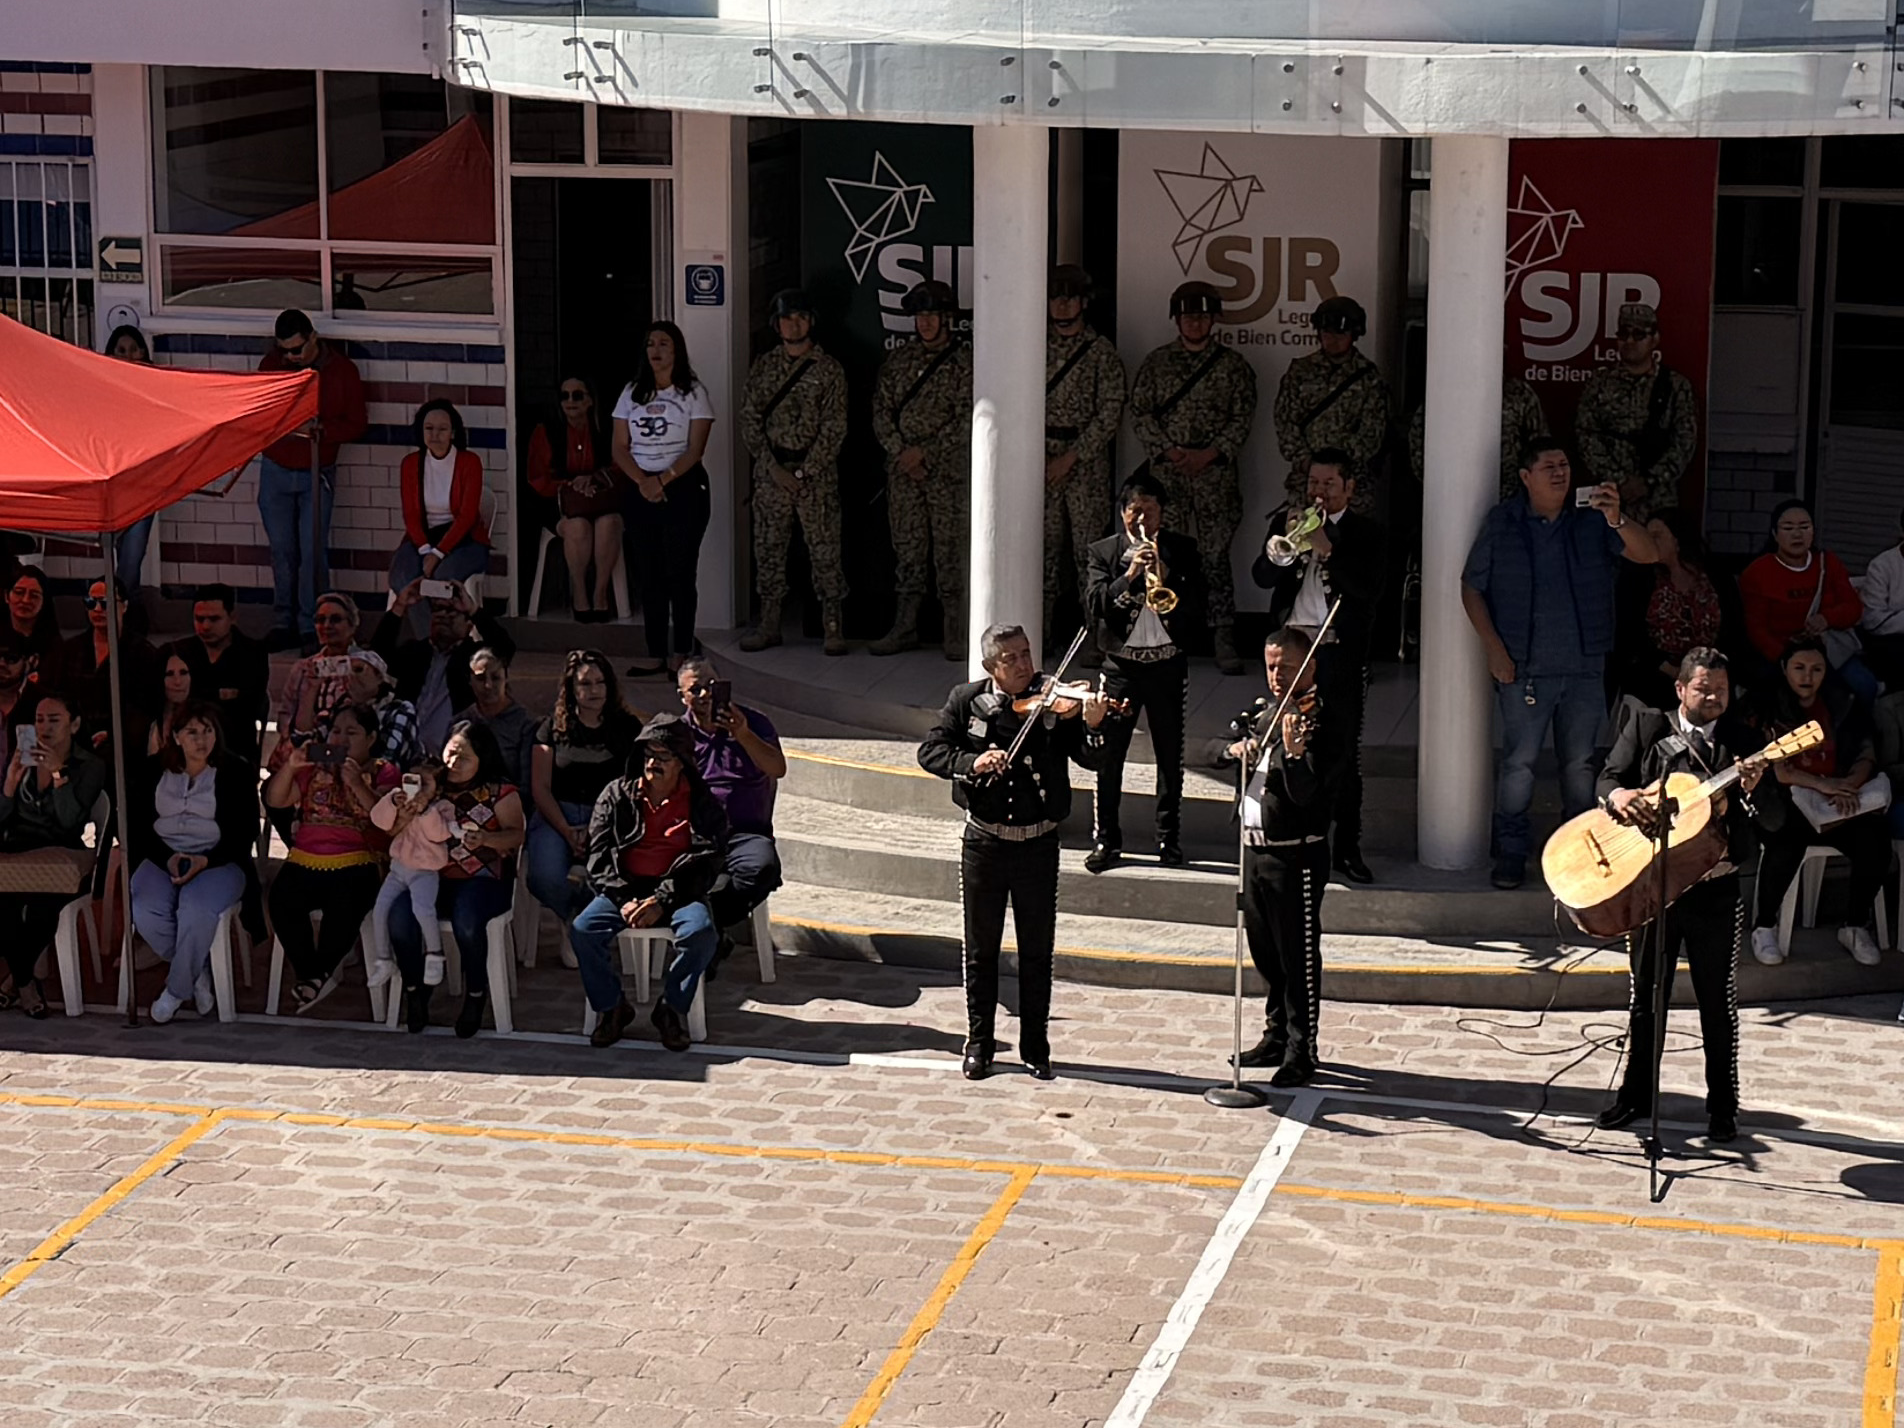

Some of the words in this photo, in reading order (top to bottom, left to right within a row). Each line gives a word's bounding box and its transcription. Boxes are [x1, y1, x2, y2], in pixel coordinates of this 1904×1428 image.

[878, 243, 973, 332] SJ
[1205, 235, 1341, 326] SJR
[1237, 329, 1276, 346] Bien
[1280, 329, 1318, 346] Com
[1278, 309, 1312, 328] Leg
[1520, 270, 1661, 361] SJR
[1524, 364, 1548, 382] de
